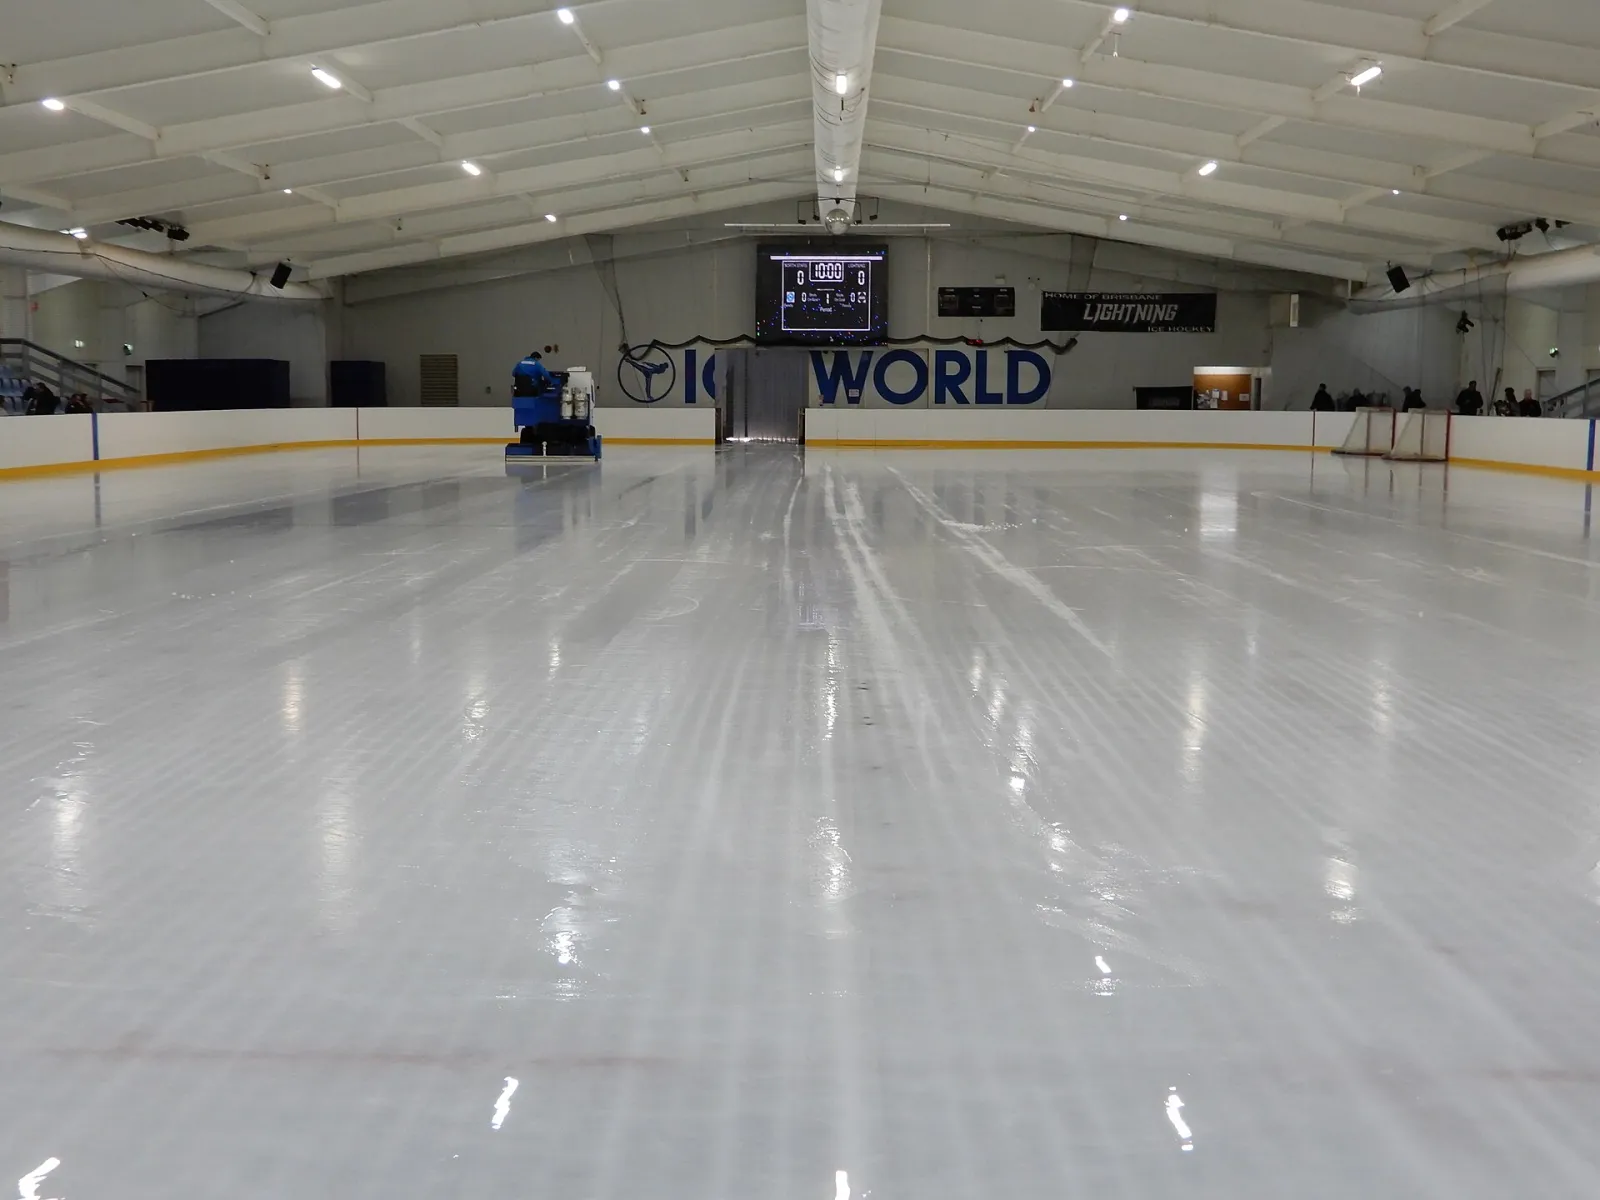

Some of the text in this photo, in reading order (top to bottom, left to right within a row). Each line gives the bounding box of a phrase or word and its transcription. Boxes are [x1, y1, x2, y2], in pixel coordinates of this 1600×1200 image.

[797, 270, 804, 285] 0
[815, 263, 842, 279] 10:00
[858, 270, 865, 285] 0
[801, 292, 807, 302] 0
[1045, 291, 1080, 299] HOME
[1083, 303, 1179, 324] LIGHTNING
[810, 349, 1052, 404] WORLD
